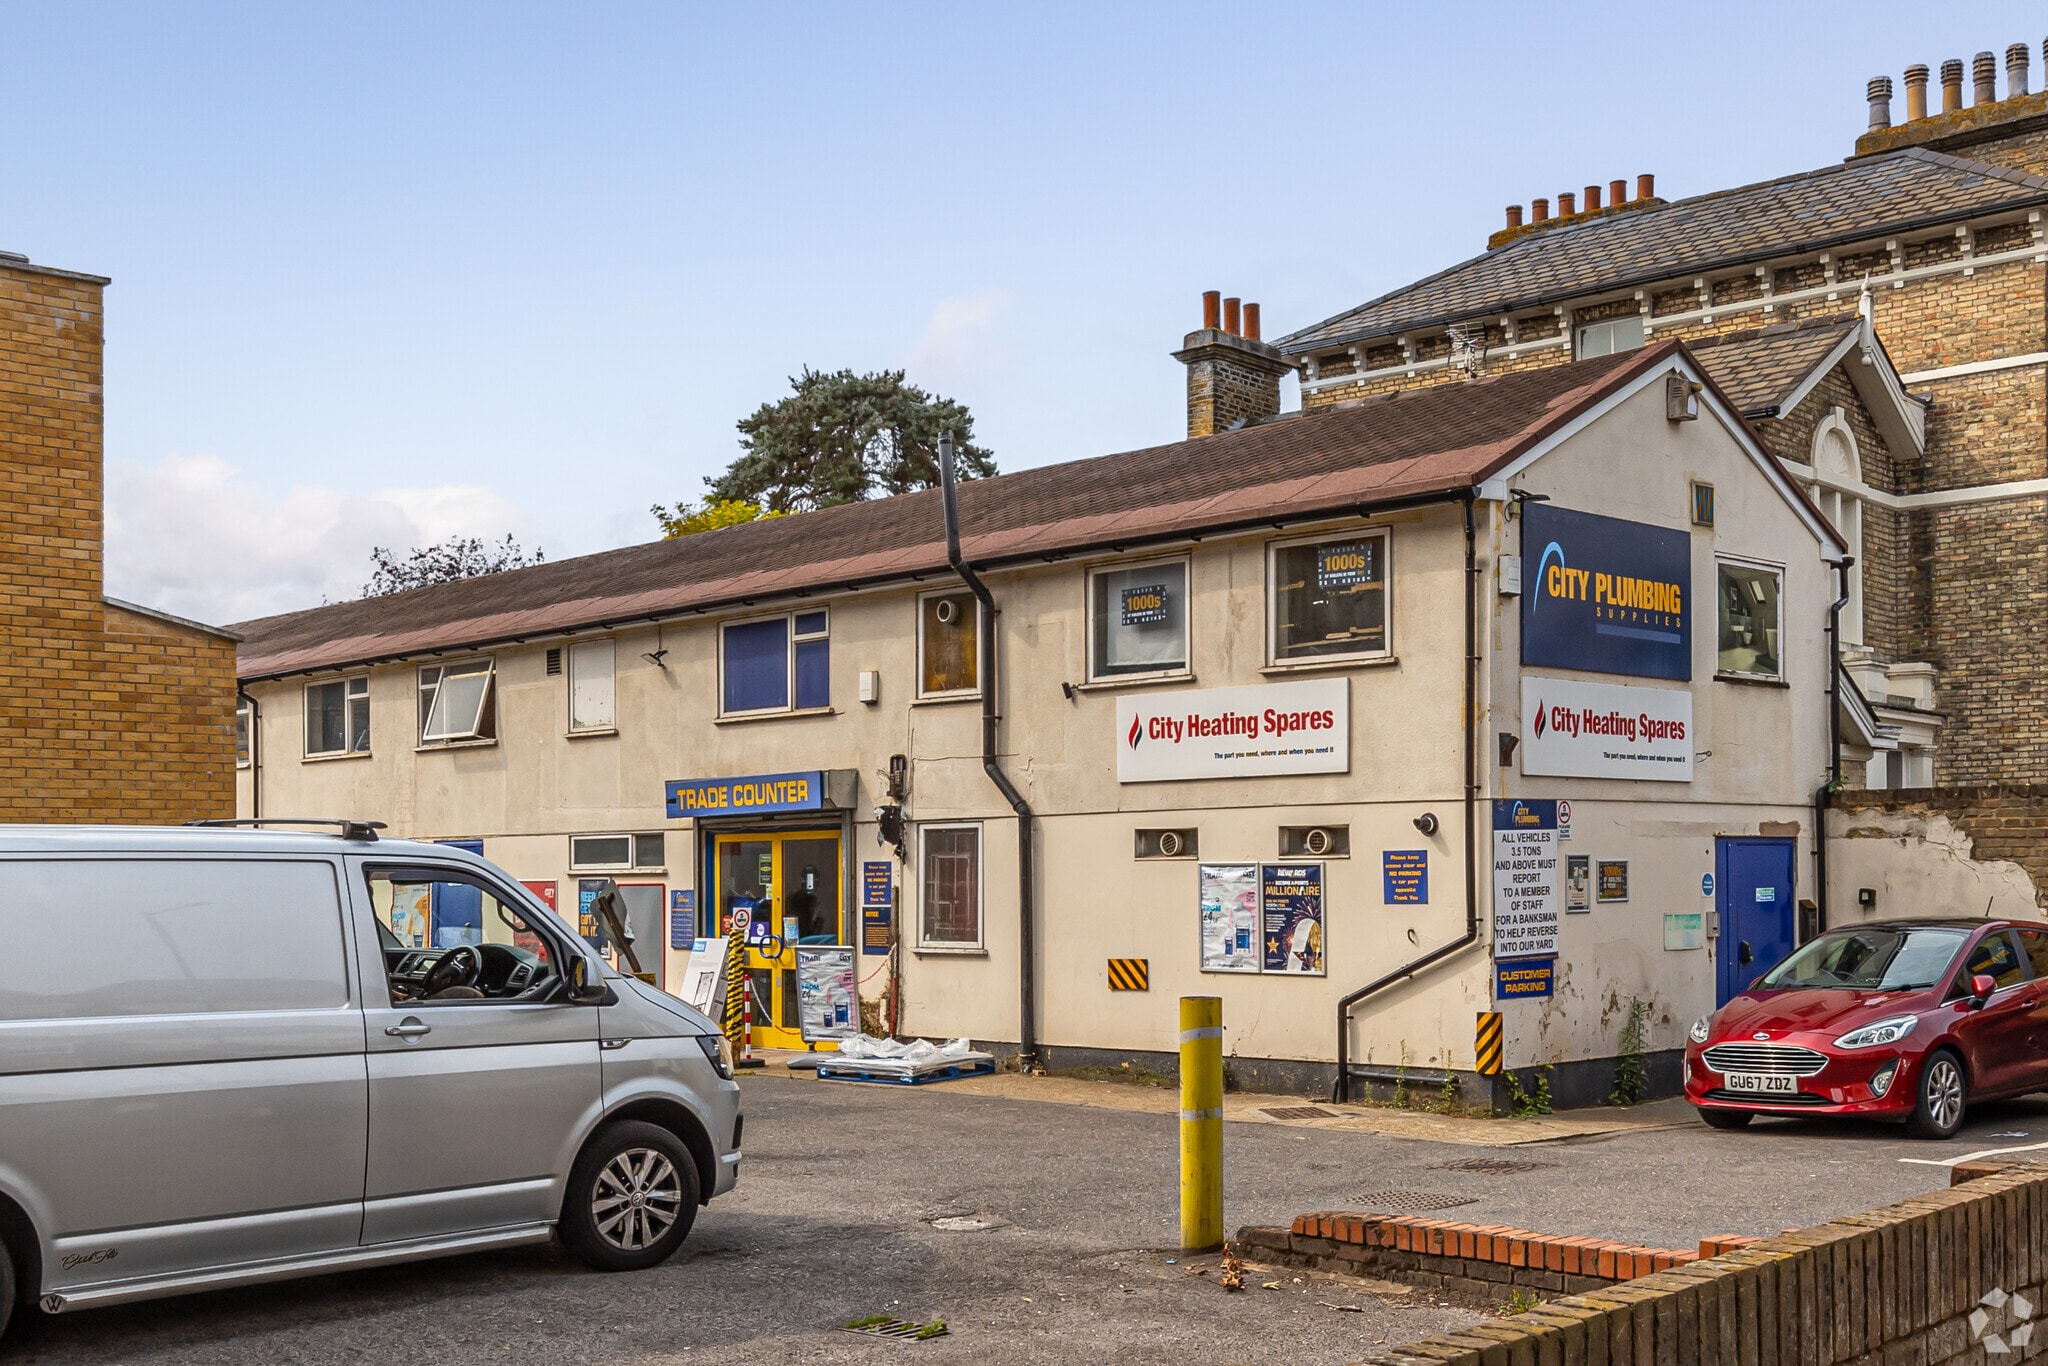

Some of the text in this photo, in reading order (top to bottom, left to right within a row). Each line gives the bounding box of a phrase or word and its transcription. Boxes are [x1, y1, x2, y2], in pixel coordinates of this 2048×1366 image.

[1325, 553, 1365, 571] 1000s
[1547, 565, 1681, 614] CITY PLUMBING
[1127, 594, 1162, 611] 1000s
[1596, 607, 1681, 628] SUPPLIES
[1149, 708, 1334, 744] City Heating Spares
[1551, 706, 1685, 743] City Heating Spares
[677, 780, 809, 810] TRADE COUNTER
[1502, 833, 1551, 843] ALL VEHICLES
[1511, 846, 1542, 857] 3.5 TONS
[1495, 859, 1556, 870] AND ABOVE MUST
[1513, 873, 1541, 883] REPORT
[1265, 886, 1320, 896] MILLIONAIRE
[1503, 886, 1551, 897] TO A MEMBER
[1511, 900, 1543, 911] OF STAFF
[1496, 912, 1557, 925] FOR A BANKSMAN
[1495, 925, 1558, 939] TO HELP REVERSE
[1501, 939, 1553, 952] INTO OUR YARD
[1500, 969, 1551, 981] CUSTOMER
[1505, 981, 1546, 993] PARKING
[1730, 1075, 1792, 1091] GU67 ZDZ
